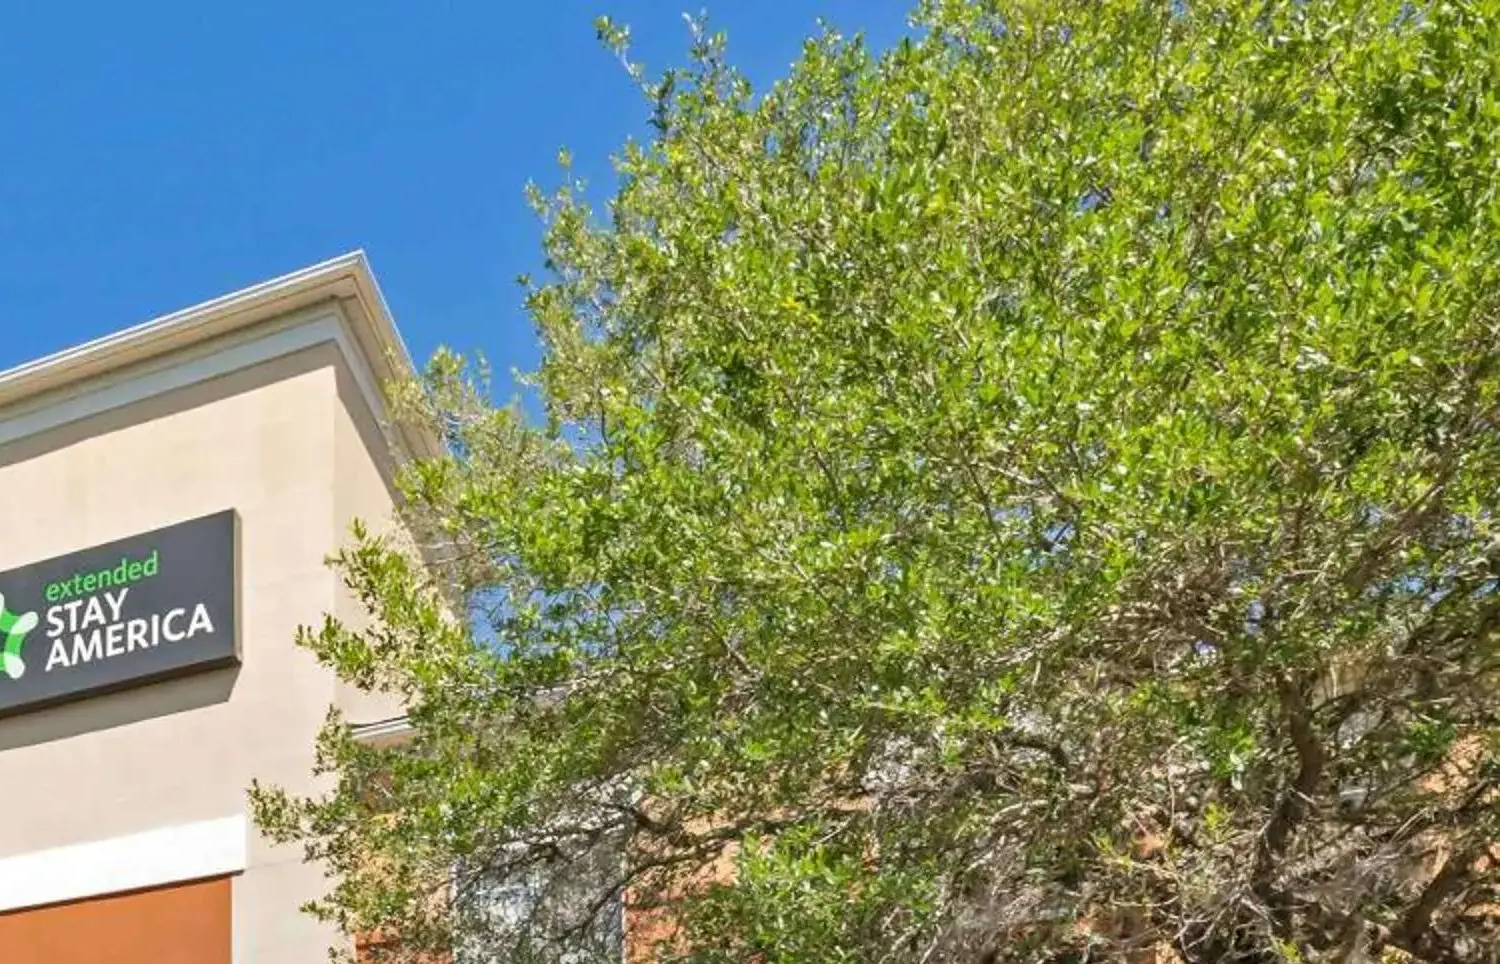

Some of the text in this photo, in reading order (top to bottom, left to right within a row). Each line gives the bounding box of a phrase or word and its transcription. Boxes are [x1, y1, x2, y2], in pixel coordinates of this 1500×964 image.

[46, 550, 158, 601] extended
[45, 603, 214, 672] AMERICA
[46, 588, 129, 638] STAY
